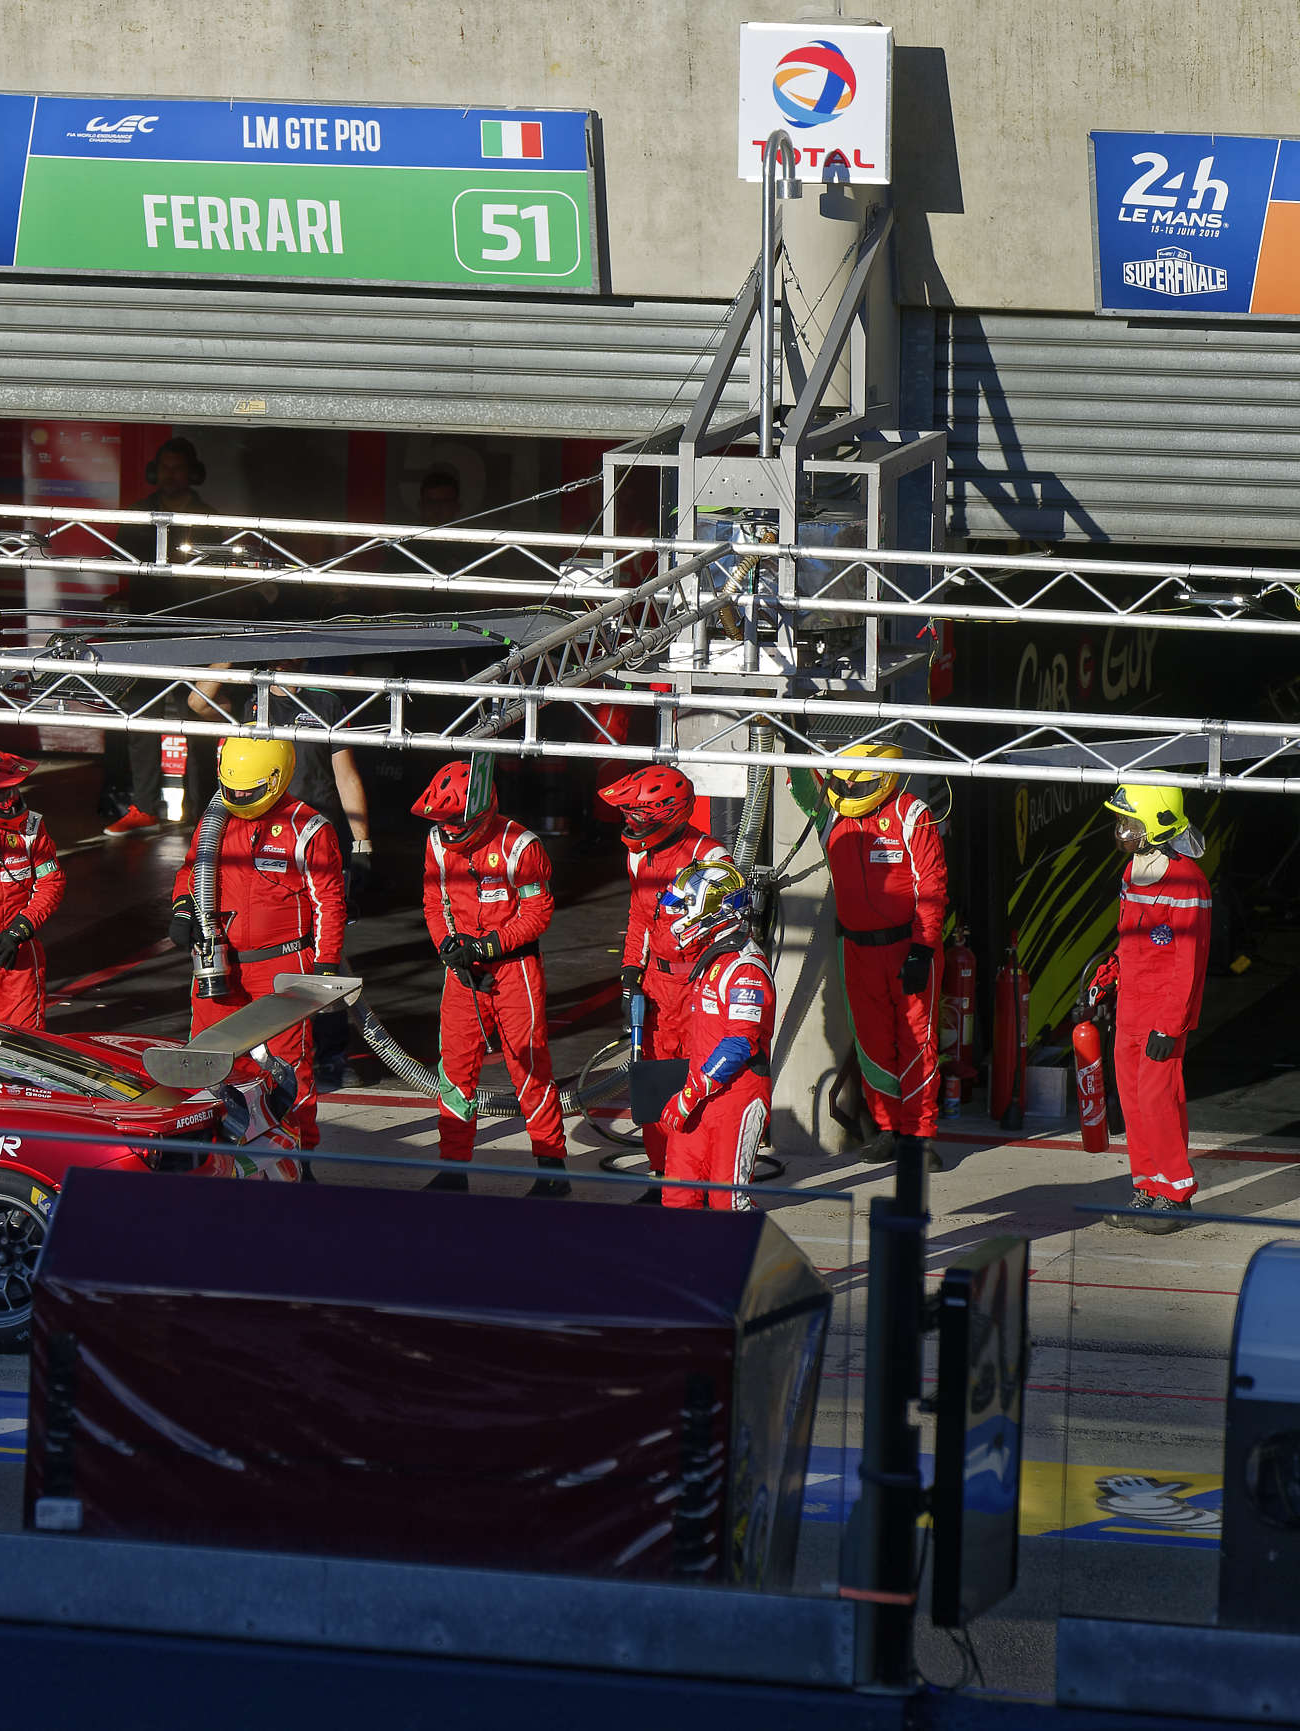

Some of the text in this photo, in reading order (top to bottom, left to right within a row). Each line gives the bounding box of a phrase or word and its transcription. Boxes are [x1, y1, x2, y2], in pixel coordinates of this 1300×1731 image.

[86, 115, 159, 133] WEC
[242, 115, 381, 153] LM GTE PRO
[752, 140, 875, 169] TOTAL
[1122, 152, 1229, 211] 24h
[143, 194, 344, 254] FERRARI
[480, 203, 551, 262] 51
[1118, 207, 1223, 229] LE MANS
[1150, 225, 1220, 238] 15-16 JUIN 2019
[1125, 258, 1227, 294] SUPERFINALE
[176, 1110, 213, 1129] AFCORSE.IT
